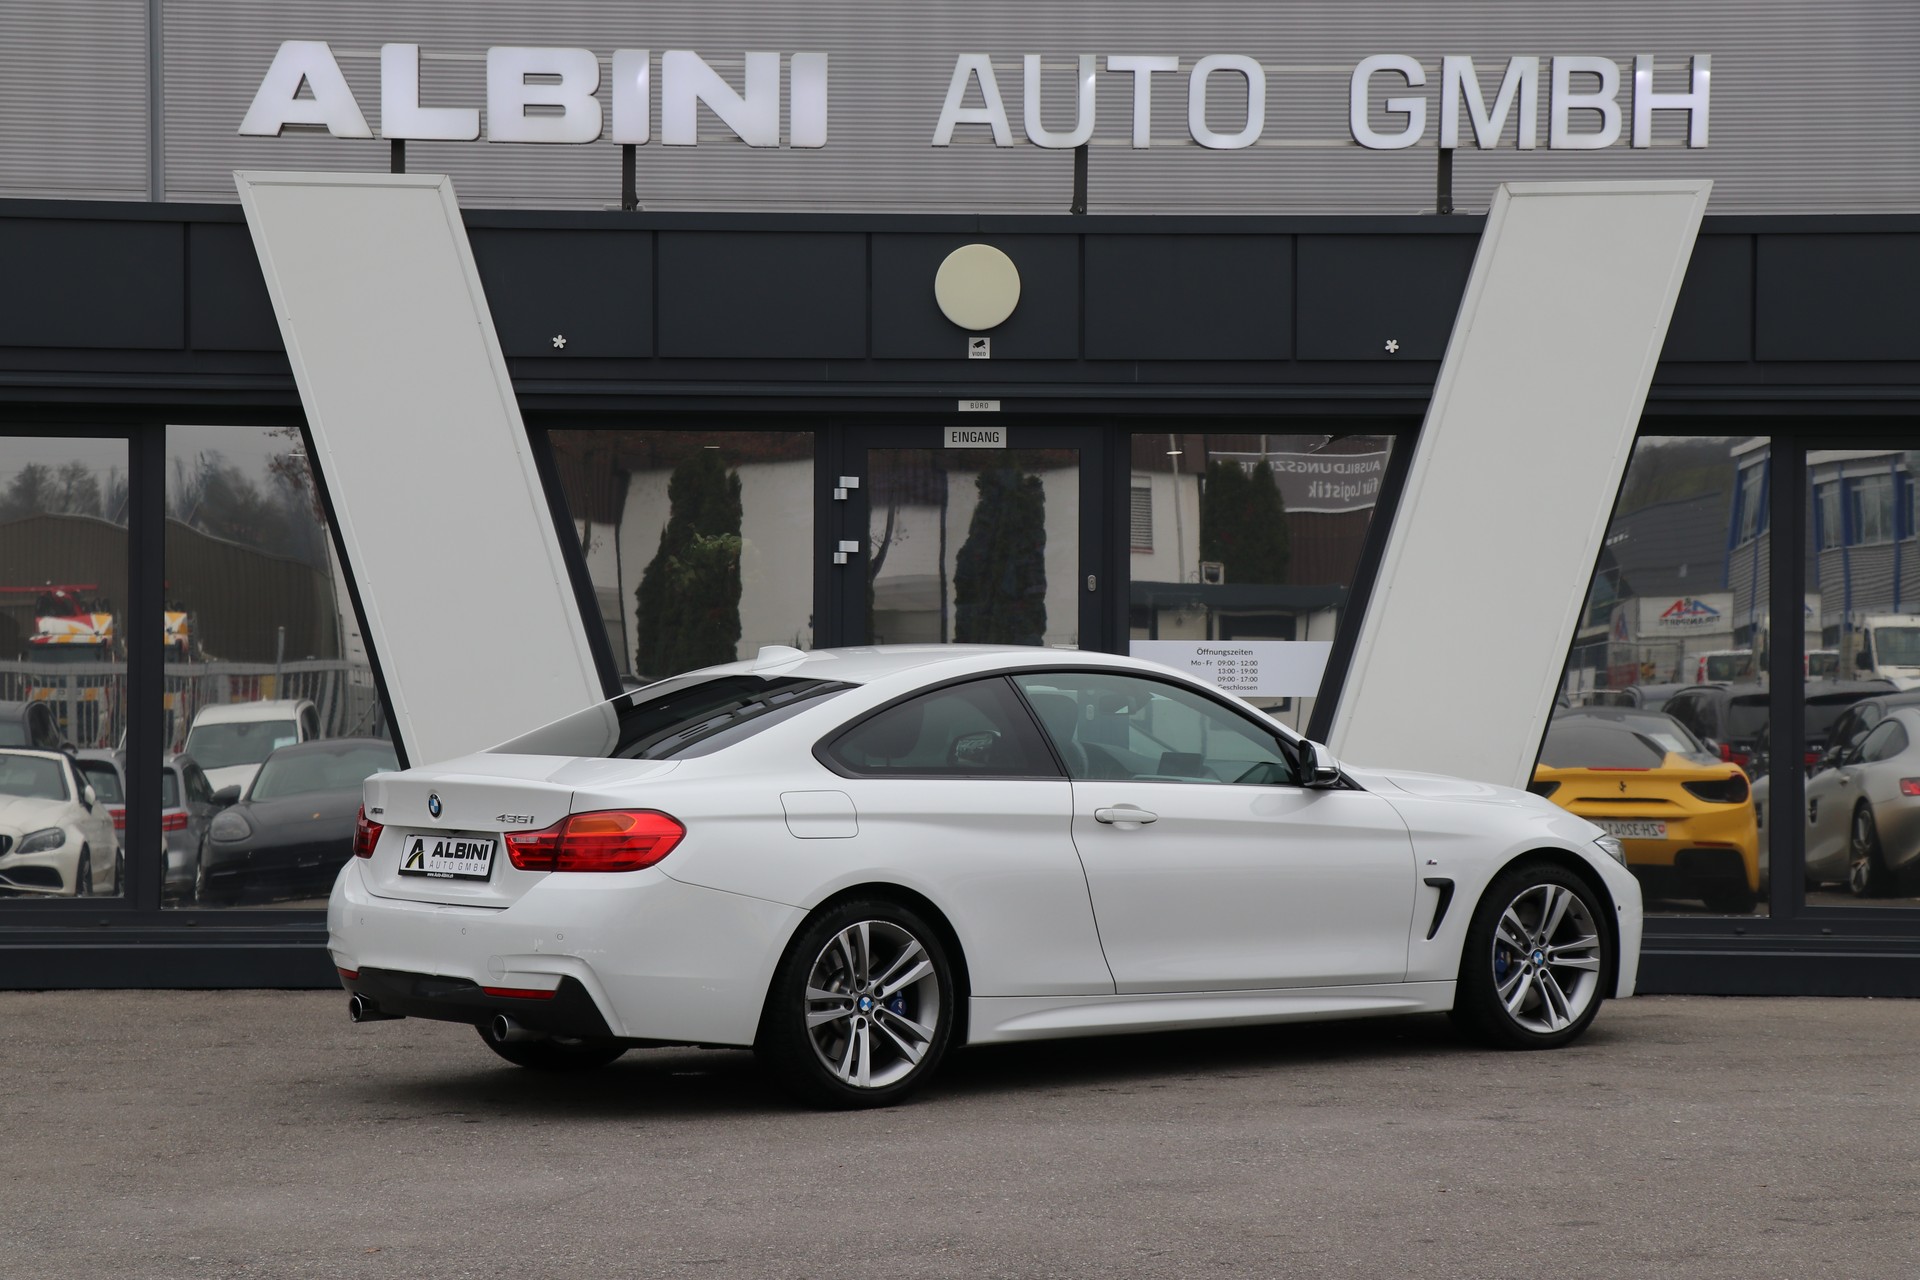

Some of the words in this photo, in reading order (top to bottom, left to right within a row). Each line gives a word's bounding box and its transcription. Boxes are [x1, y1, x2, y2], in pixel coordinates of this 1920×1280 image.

[238, 40, 829, 149] ALBINI
[931, 53, 1266, 150] AUTO
[1349, 54, 1712, 151] GMBH
[951, 431, 1000, 443] EINGANG
[1196, 647, 1253, 656] Öffnungszeiten
[496, 813, 535, 825] 435i
[431, 841, 490, 861] ALBINI
[428, 860, 455, 870] AUTO
[457, 862, 487, 873] GMBH
